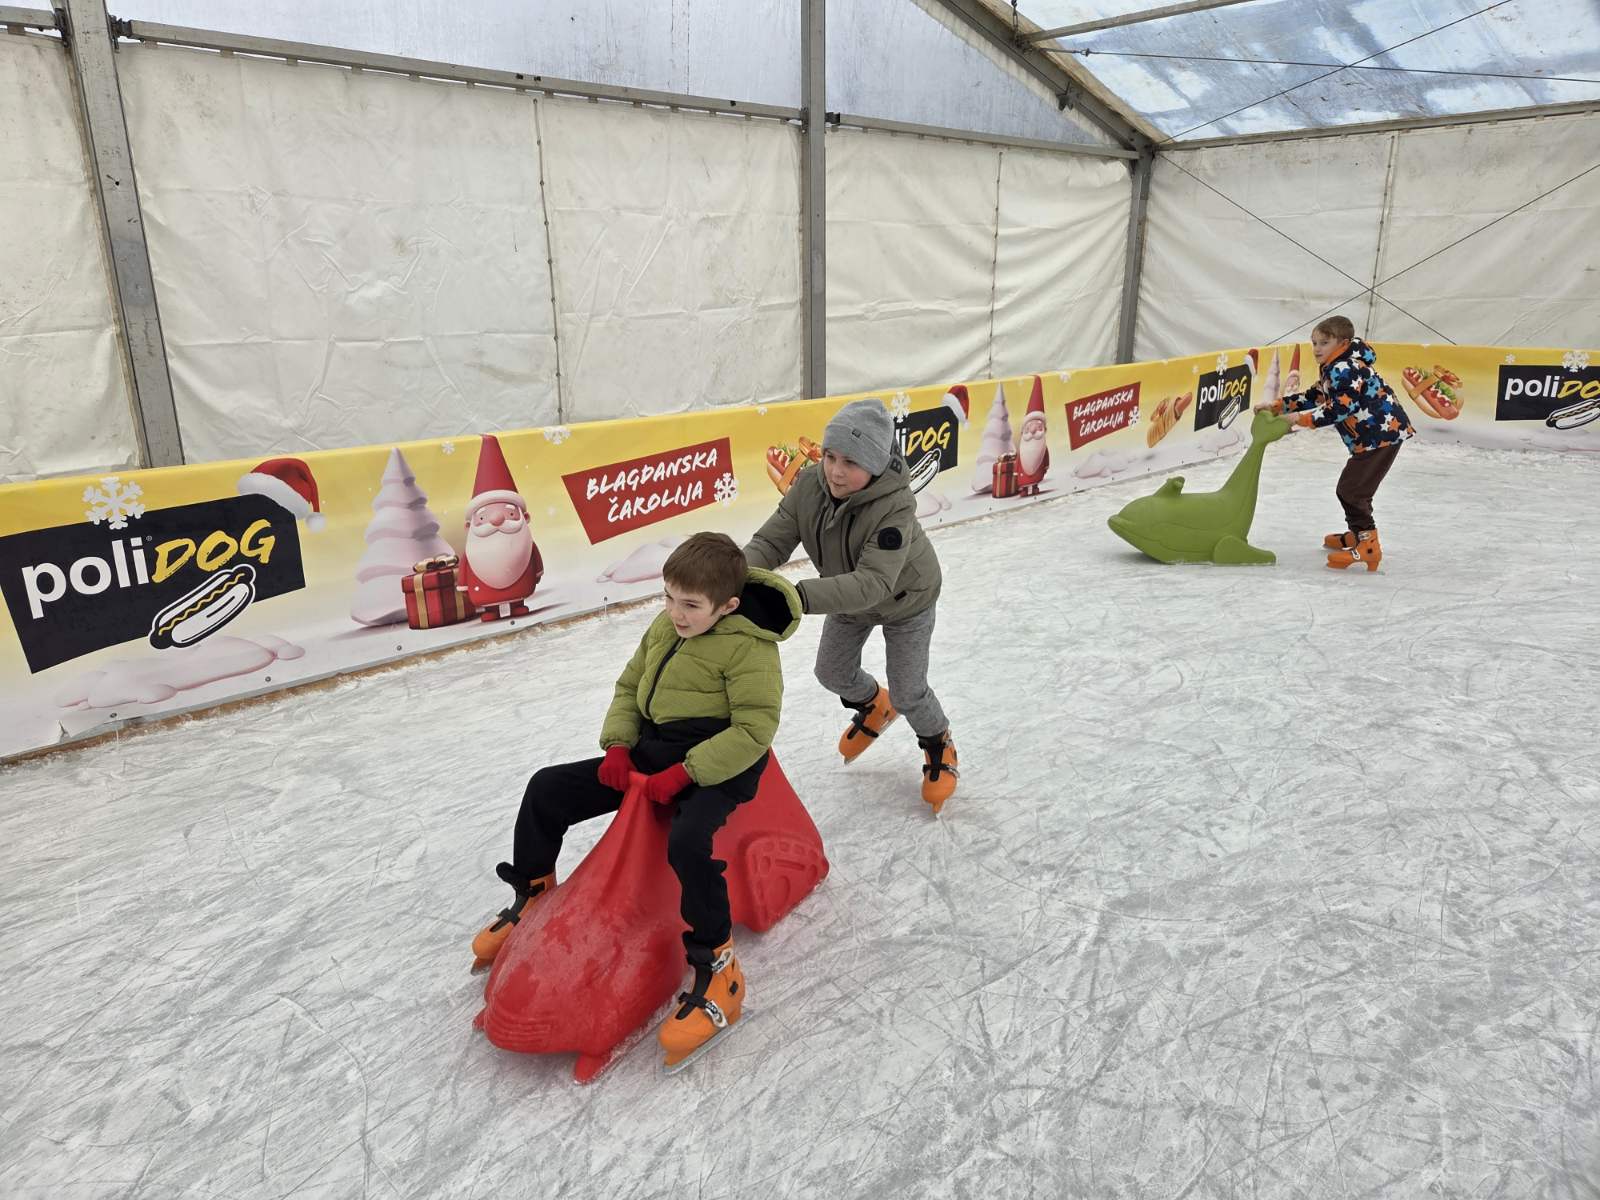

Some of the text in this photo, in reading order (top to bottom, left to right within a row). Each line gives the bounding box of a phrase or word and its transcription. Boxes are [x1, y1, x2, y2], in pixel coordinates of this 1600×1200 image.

[1072, 389, 1134, 421] BLAGDANSKA
[1504, 375, 1600, 401] poliDO
[895, 421, 950, 457] liDOG
[1080, 411, 1124, 437] ČAROLIJA
[586, 448, 717, 500] BLAGDANSKA
[608, 480, 703, 523] ČAROLIJA
